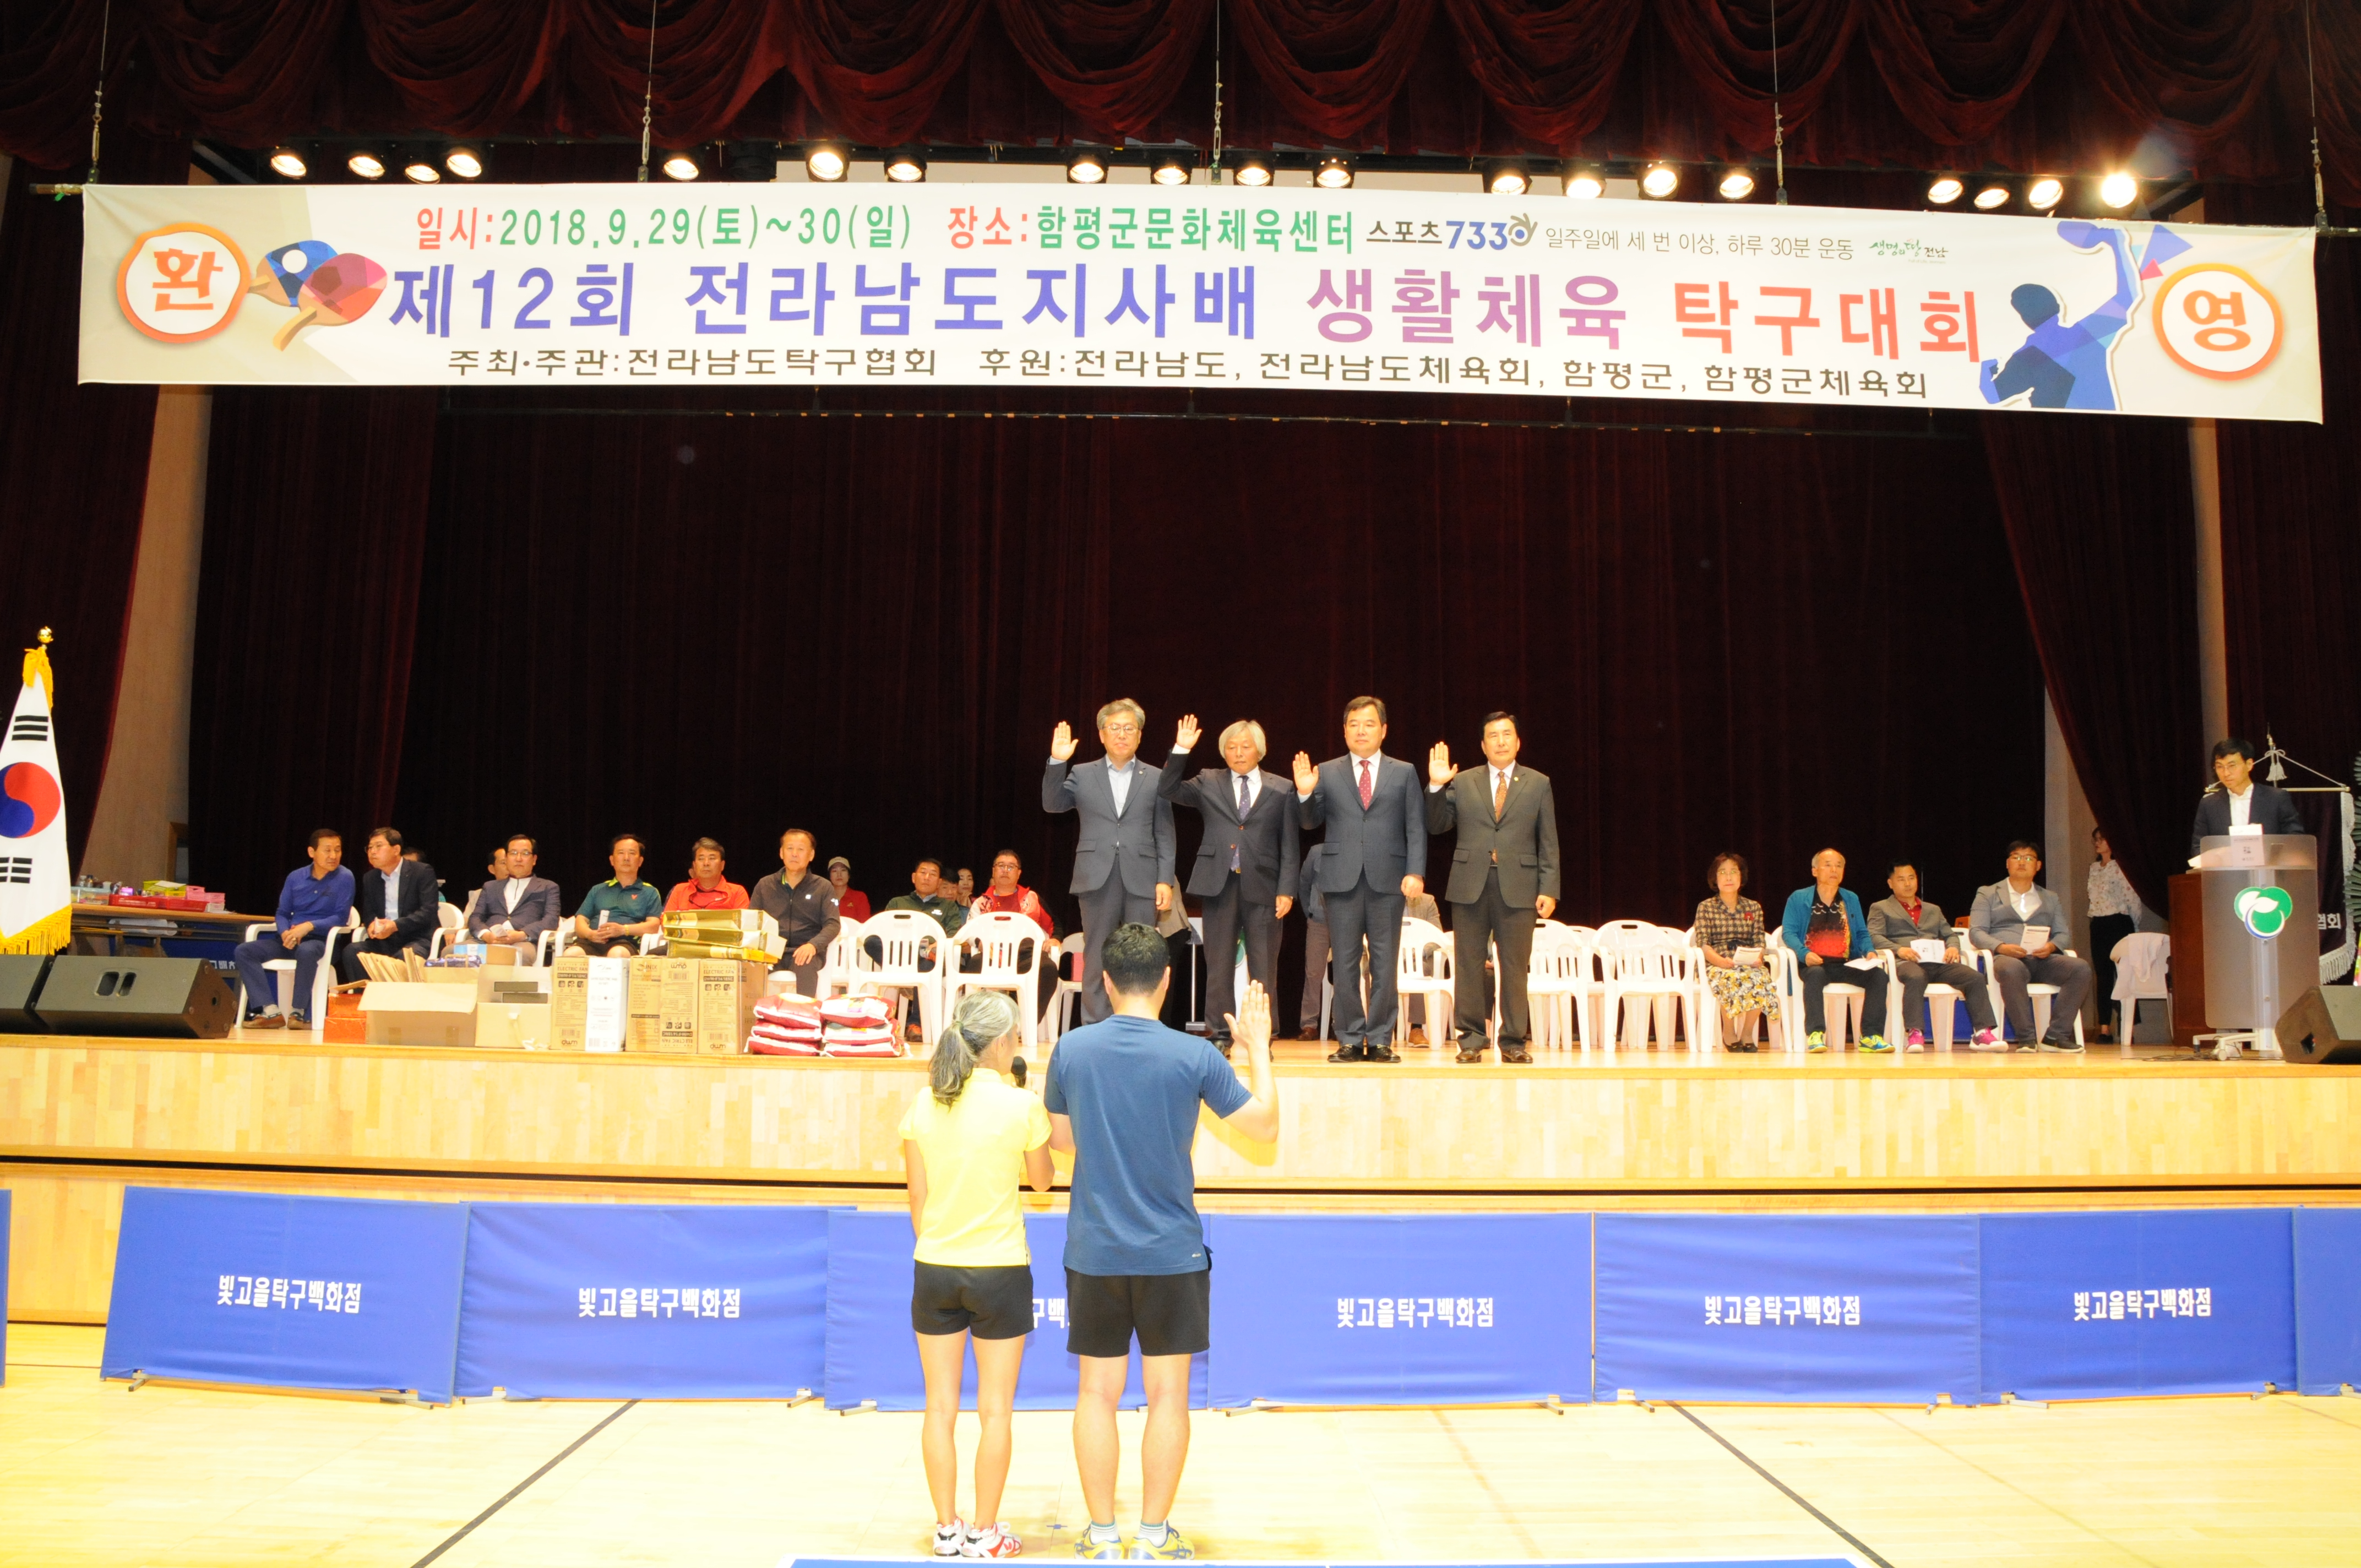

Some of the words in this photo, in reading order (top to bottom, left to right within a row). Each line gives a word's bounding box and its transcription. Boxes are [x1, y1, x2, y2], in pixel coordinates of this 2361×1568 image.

[948, 206, 1351, 254] 장소:함평군문화체육센터
[1546, 228, 1618, 250] 일주일에
[1628, 231, 1644, 251] 세
[1653, 232, 1669, 252] 번
[1679, 233, 1718, 255] 이상,
[1728, 235, 1763, 255] 하루
[1771, 237, 1810, 258] 30분
[1818, 238, 1853, 260] 운동
[1924, 247, 1949, 258] 전남
[153, 248, 222, 311] 환
[389, 263, 633, 337] 제12회
[685, 262, 1254, 339] 전라남도지사배
[1307, 269, 1625, 349] 생활체육
[1675, 281, 1979, 362] 탁구대회
[2183, 290, 2251, 351] 영
[980, 349, 1240, 380] 후원:전라남도,
[1260, 353, 1544, 388] 전라남도체육회,
[1564, 360, 1685, 392] 함평군,
[1705, 365, 1926, 398] 함평군체육회
[217, 1276, 361, 1313] 빛고을탁구백화점
[579, 1288, 740, 1317] 빛고을탁구백화점
[1705, 1296, 1859, 1325] 빛고을탁구백화점
[2074, 1288, 2211, 1321] 빛고을탁구백화점
[1337, 1298, 1493, 1328] 빛고을탁구백화점
